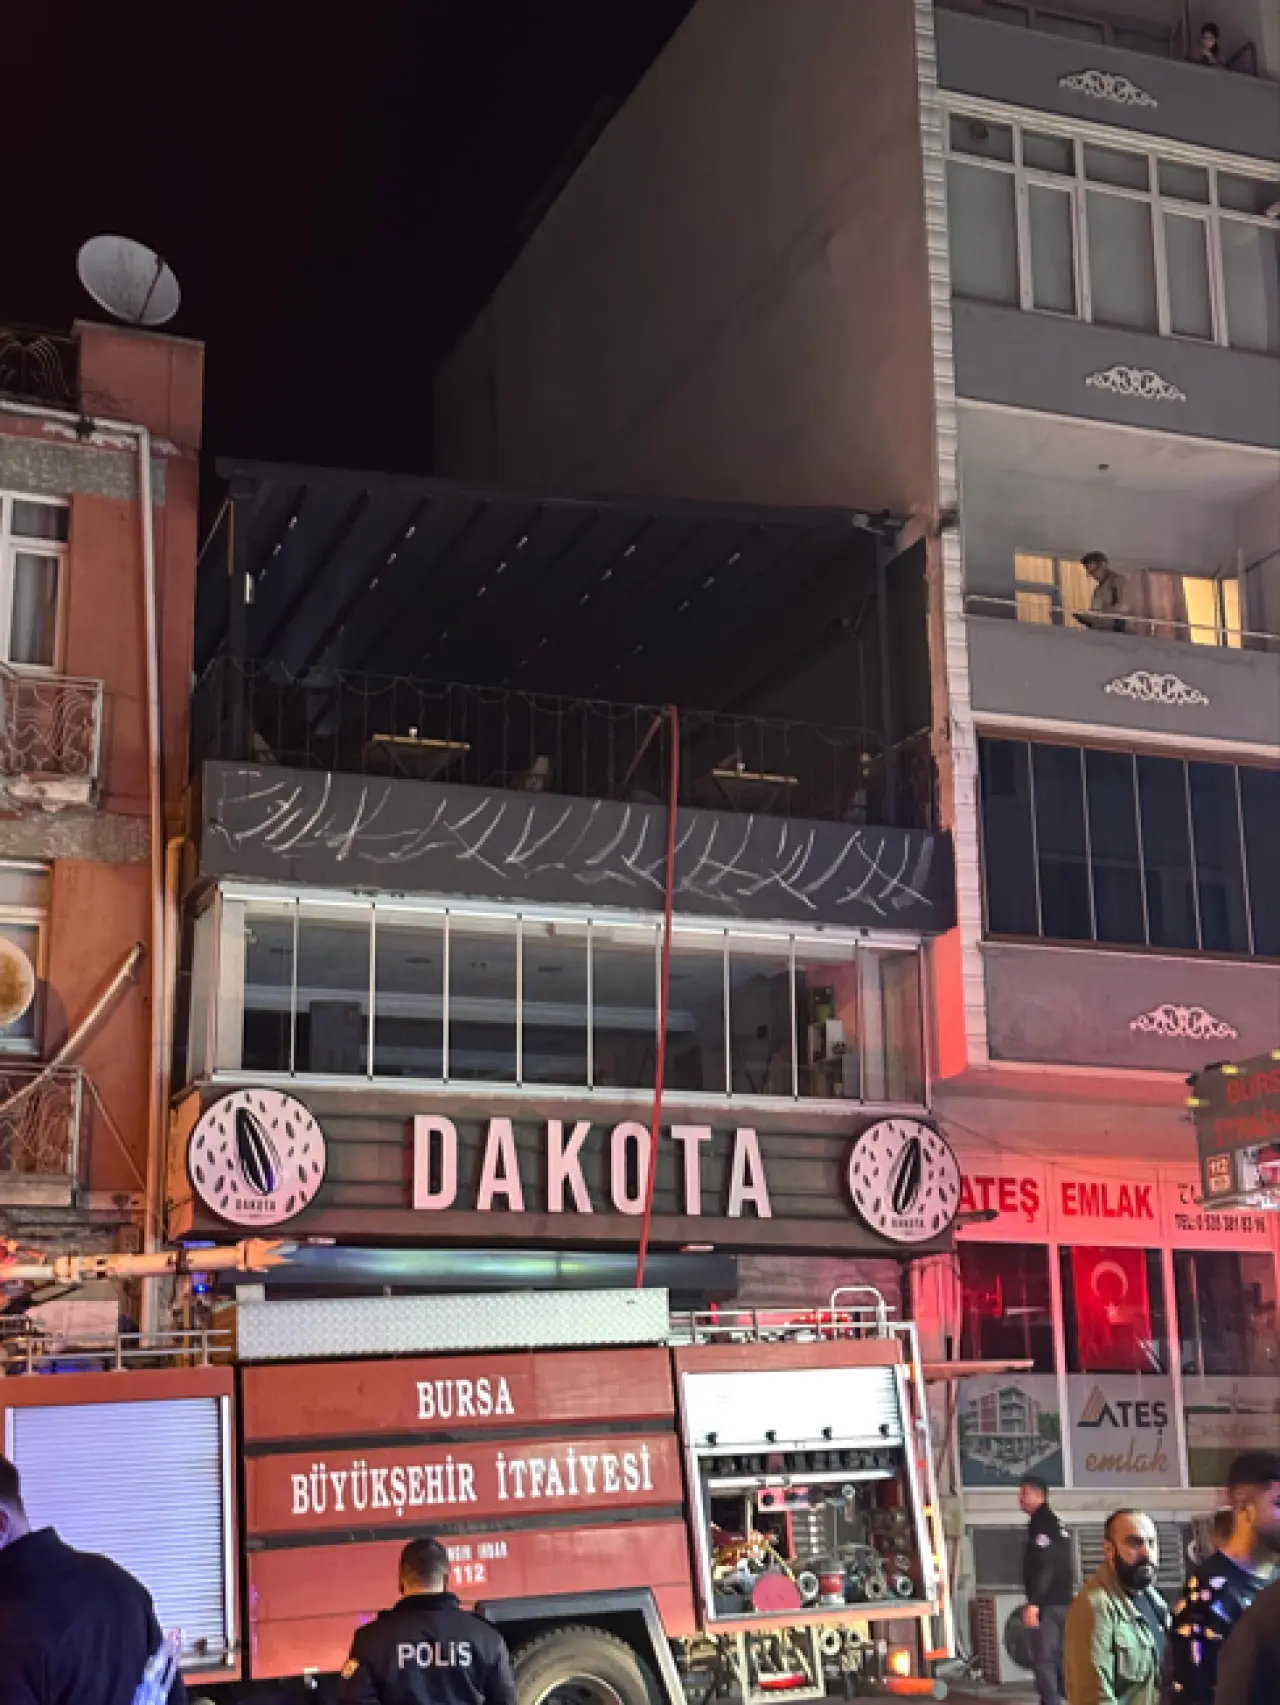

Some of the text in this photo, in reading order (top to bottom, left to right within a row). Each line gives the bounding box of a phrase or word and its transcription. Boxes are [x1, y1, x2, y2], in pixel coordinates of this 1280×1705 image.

[413, 1114, 773, 1219] DAKOTA
[235, 1198, 277, 1212] DAKOTA
[959, 1176, 1040, 1223] ATEŞ
[1061, 1182, 1154, 1219] EMLAK
[416, 1376, 515, 1419] BURSA
[1078, 1398, 1168, 1435] ATEŞ
[1085, 1437, 1169, 1473] emlak
[291, 1442, 654, 1516] BÜYÜKŞEHİR İTFAİYESİ
[453, 1562, 486, 1585] 112
